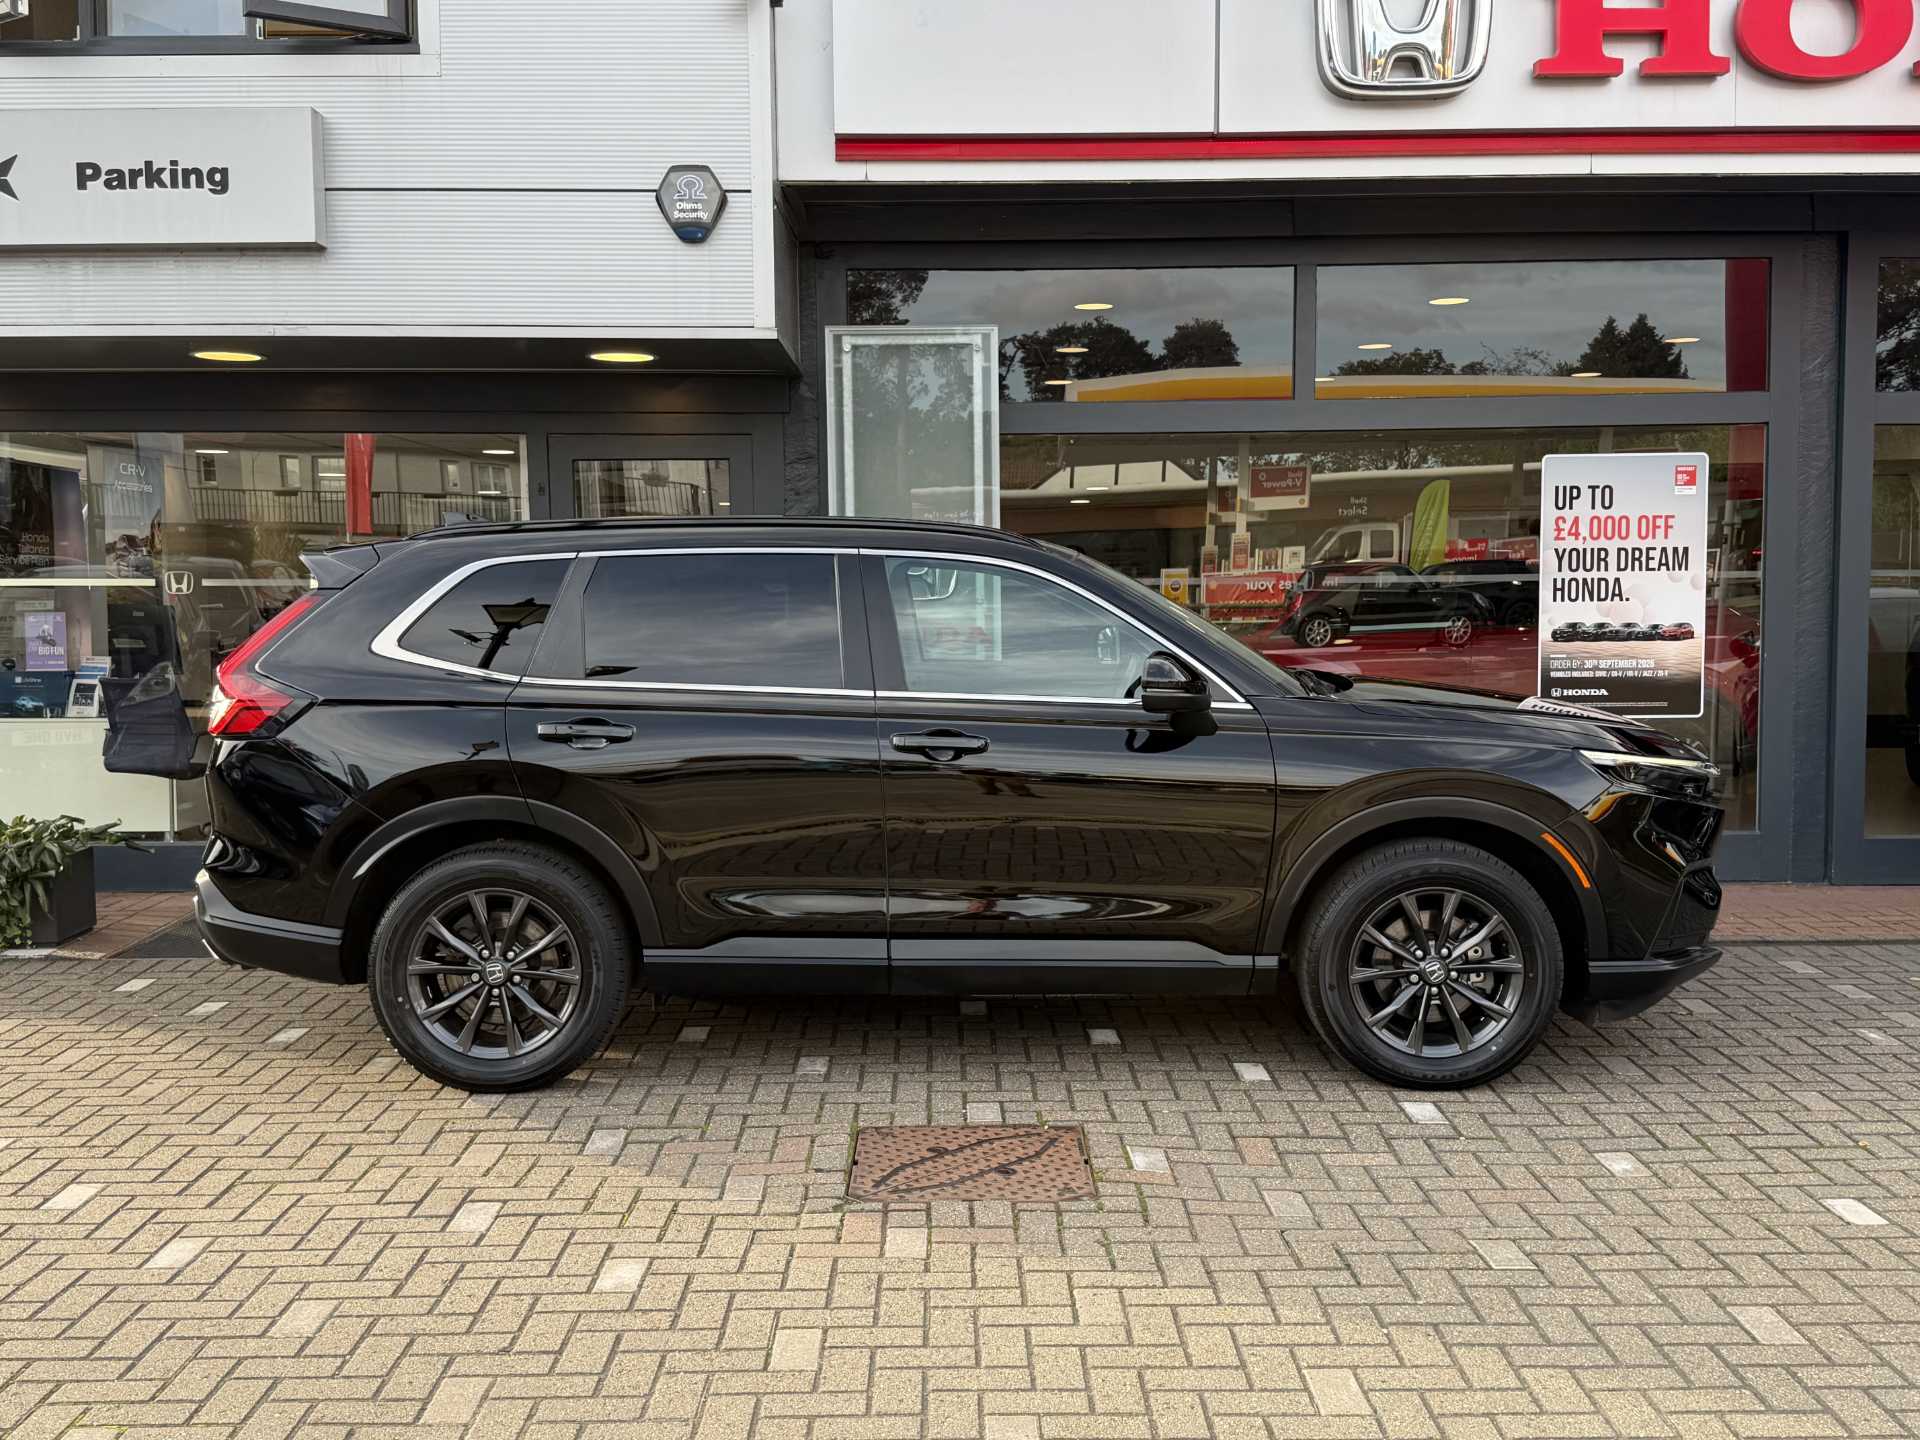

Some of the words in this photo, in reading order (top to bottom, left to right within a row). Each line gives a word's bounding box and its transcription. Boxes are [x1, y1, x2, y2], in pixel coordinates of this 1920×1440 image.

[1532, 0, 1920, 82] HO
[76, 160, 229, 195] Parking
[676, 201, 702, 210] Ohms
[673, 211, 708, 220] Security
[120, 463, 146, 477] CR-V
[1554, 485, 1581, 510] UP
[1588, 485, 1614, 510] TO
[1554, 515, 1630, 544] £4,000
[1637, 515, 1675, 540] OFF
[1554, 547, 1609, 572] YOUR
[1616, 546, 1689, 572] DREAM
[1552, 577, 1630, 603] HONDA.
[38, 646, 49, 655] BIG
[51, 646, 65, 656] FUN
[1550, 659, 1571, 669] ORDER
[1599, 659, 1637, 669] SEPTEMBER
[1562, 688, 1609, 696] HONDA
